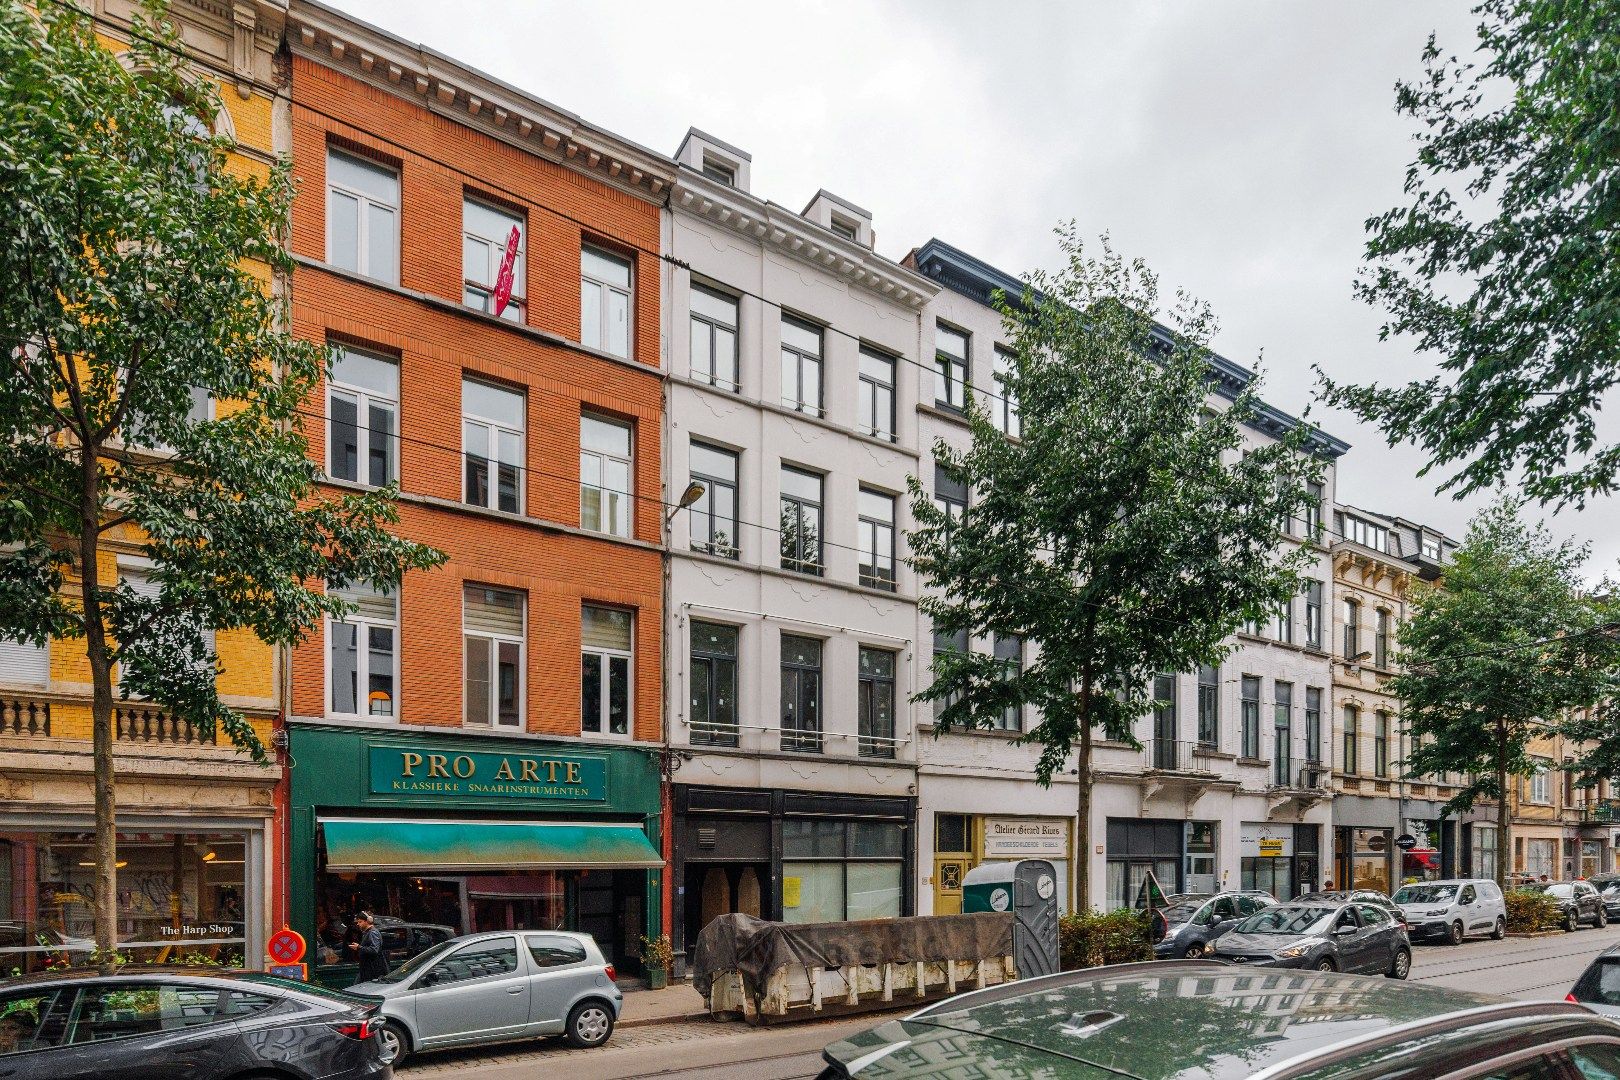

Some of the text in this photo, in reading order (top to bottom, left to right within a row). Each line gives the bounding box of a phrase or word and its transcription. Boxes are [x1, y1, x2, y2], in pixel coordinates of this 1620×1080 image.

[401, 752, 582, 784] PRO ARTE
[393, 781, 589, 796] KLASSIEKE SNAARINSTRUMENTEN
[994, 824, 1016, 835] Atelier
[1017, 824, 1040, 835] Gérard
[160, 924, 234, 936] The Harp Shop
